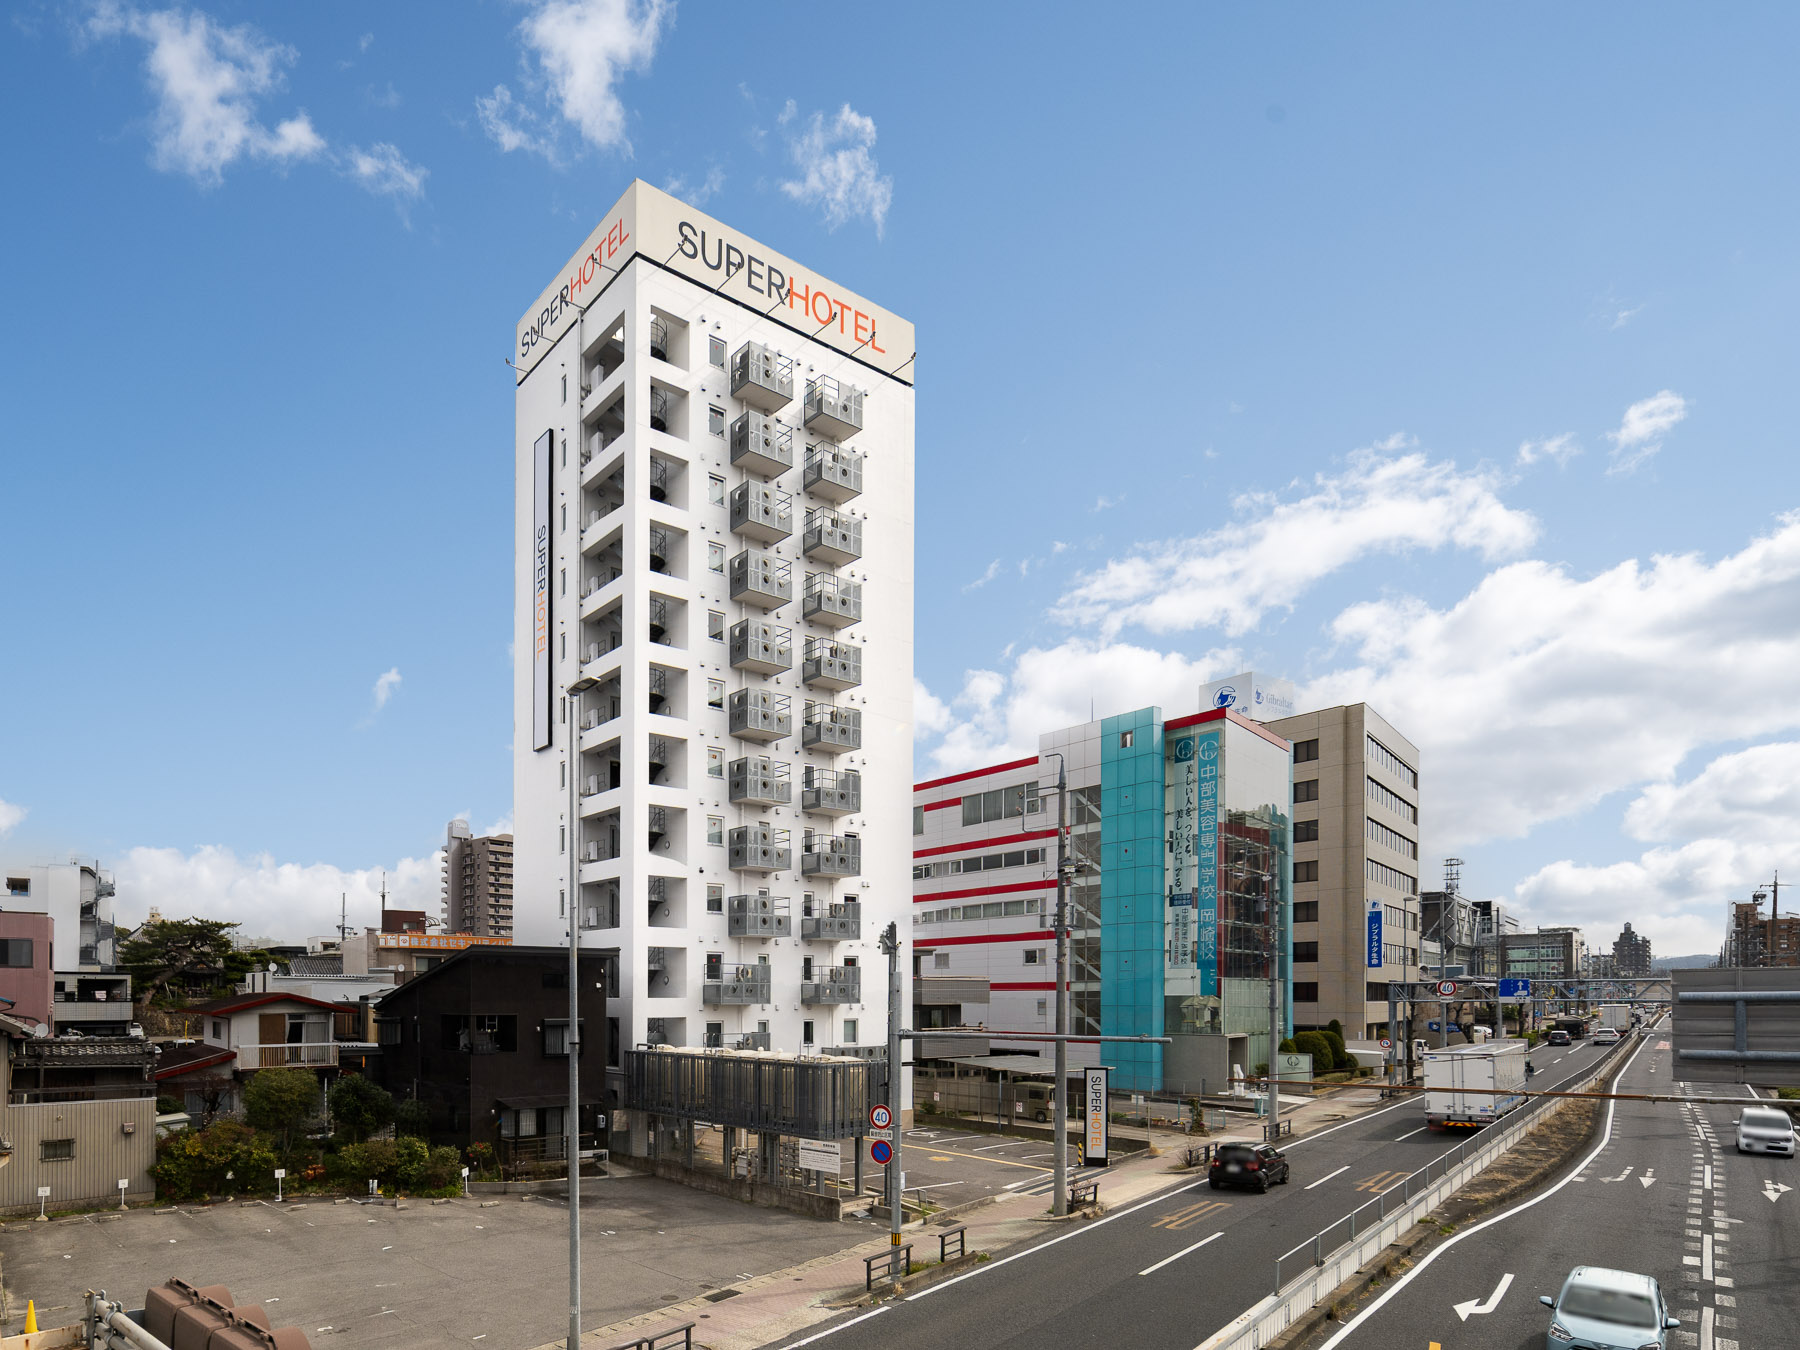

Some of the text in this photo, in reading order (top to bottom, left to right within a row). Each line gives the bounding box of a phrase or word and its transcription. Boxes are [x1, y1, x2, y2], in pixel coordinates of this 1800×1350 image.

[1371, 923, 1379, 965] ジブラルタ生命
[1442, 983, 1453, 993] 40
[875, 1112, 887, 1123] 40
[1091, 1076, 1102, 1151] SUPERHOTEL
[1150, 1200, 1233, 1230] 40
